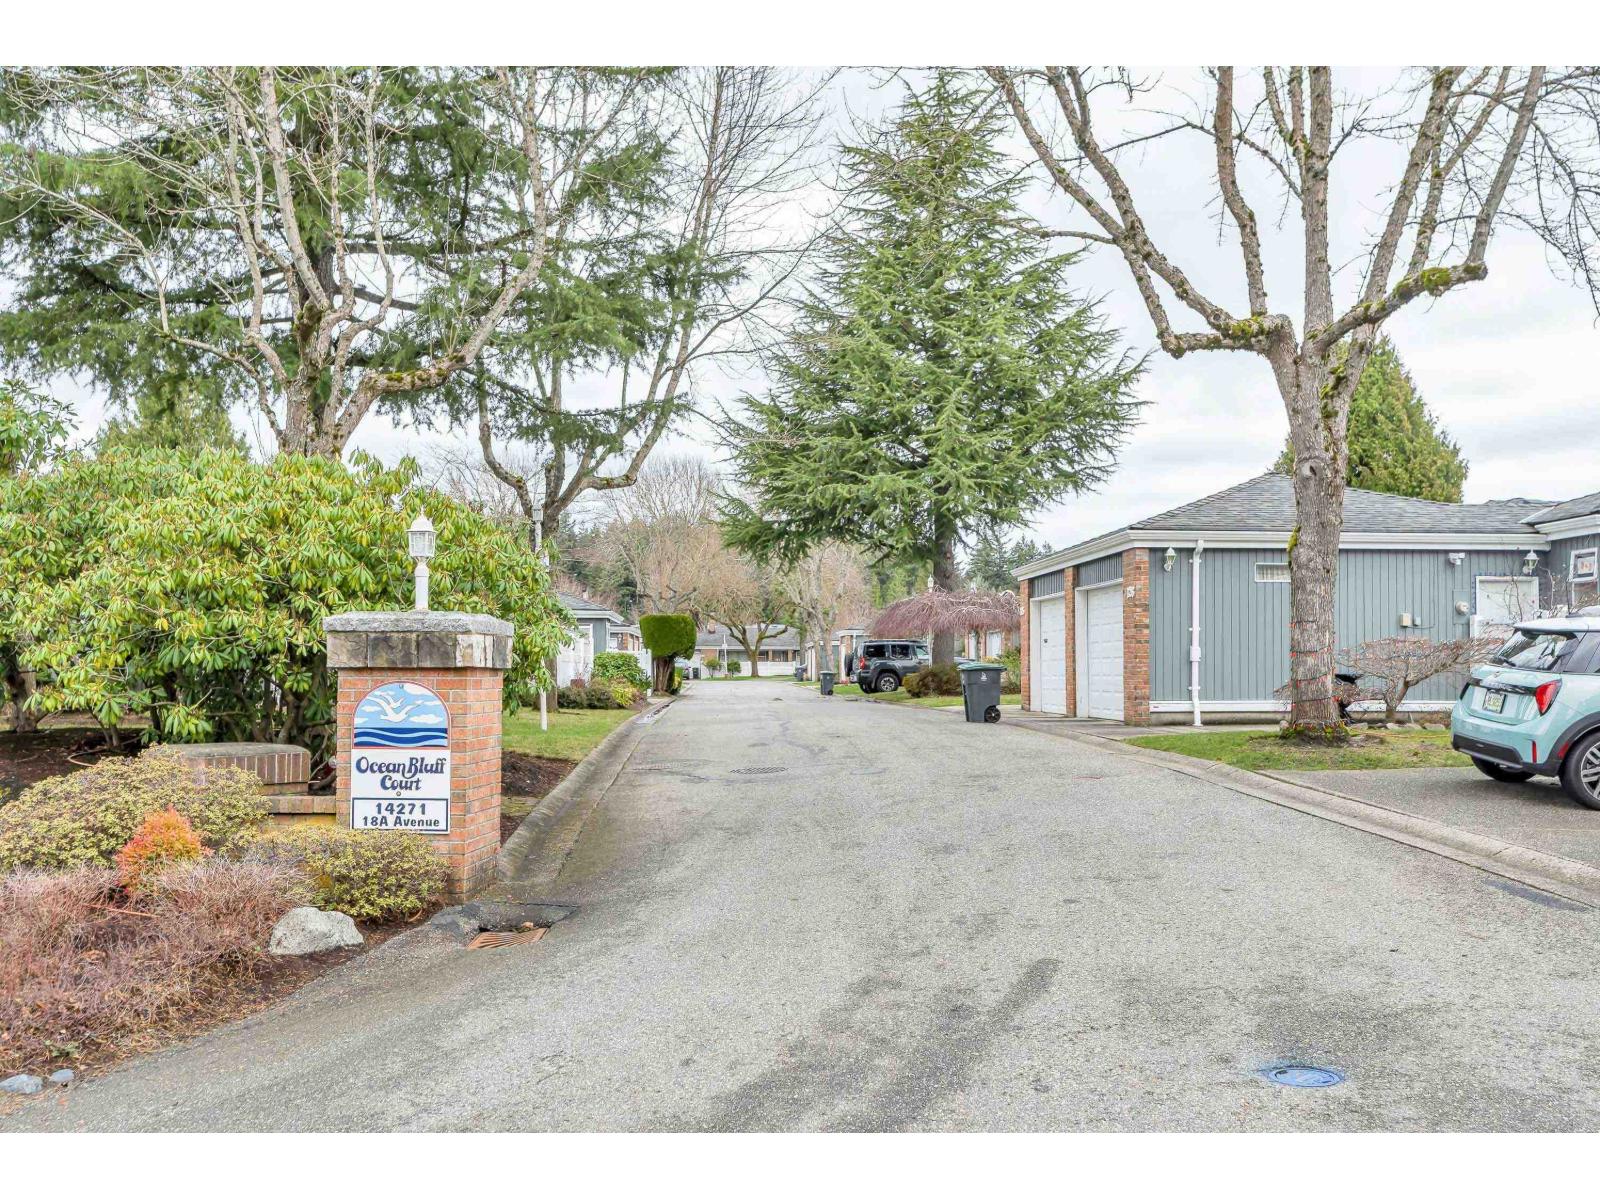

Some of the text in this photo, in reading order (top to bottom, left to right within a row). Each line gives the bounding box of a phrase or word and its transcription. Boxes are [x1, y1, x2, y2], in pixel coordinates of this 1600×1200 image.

[355, 756, 446, 779] Ocean Bluff
[380, 775, 421, 790] Court
[375, 803, 426, 815] 14271
[363, 816, 440, 827] 18A Avenue
